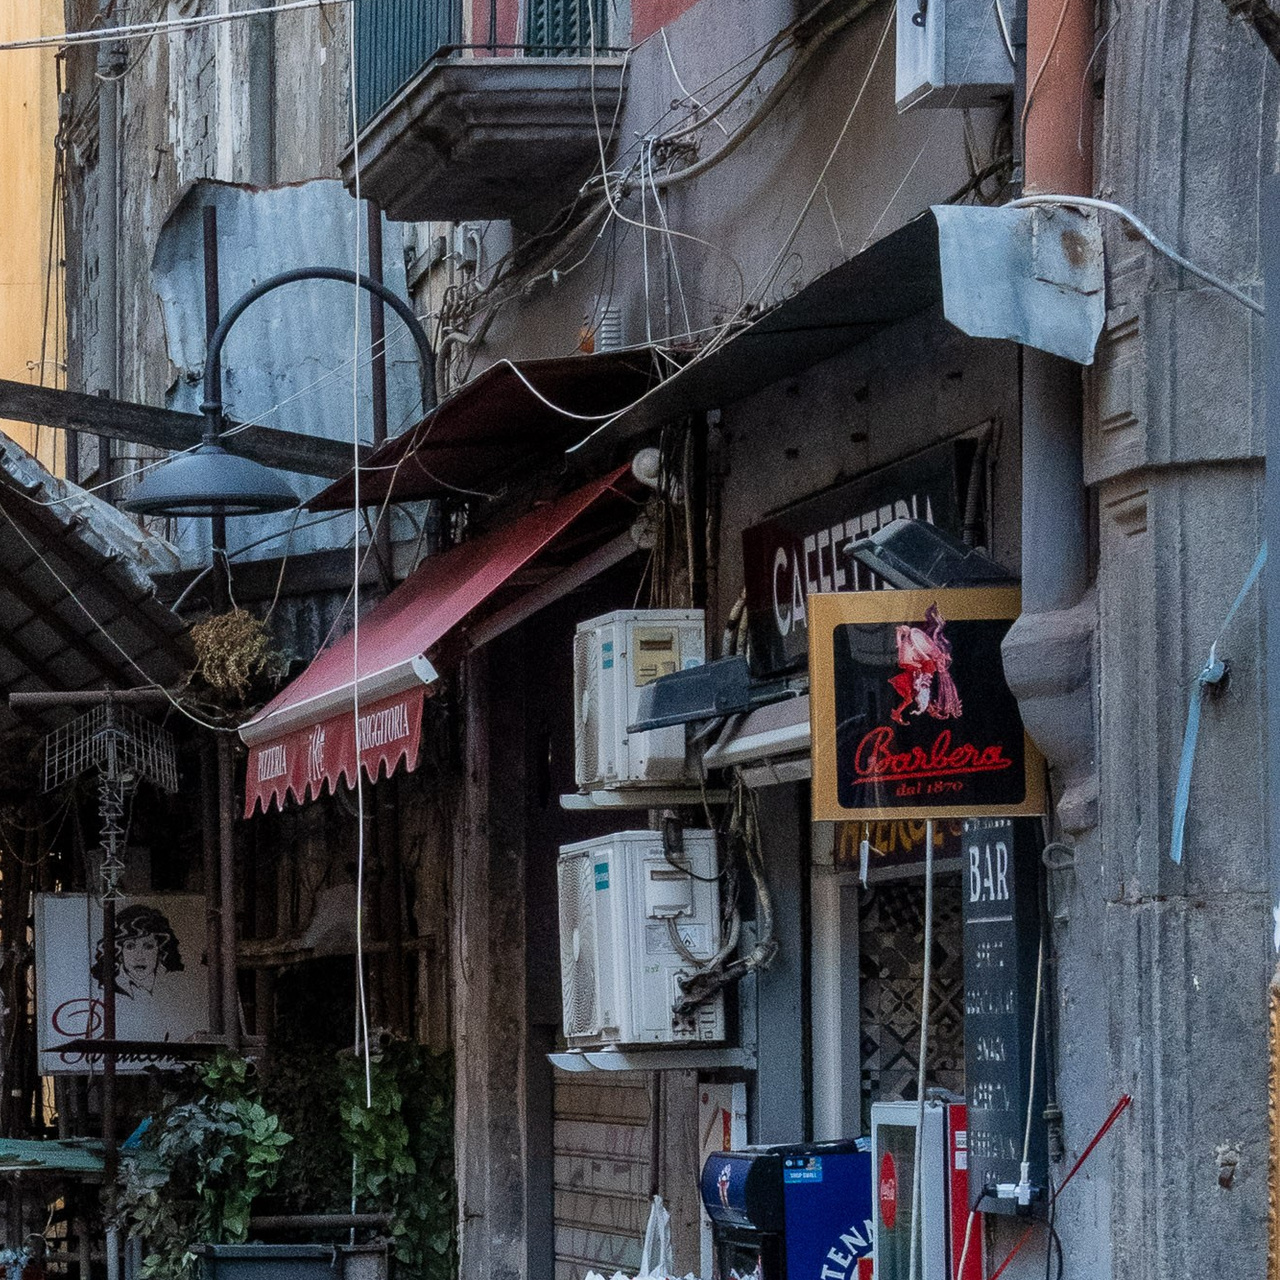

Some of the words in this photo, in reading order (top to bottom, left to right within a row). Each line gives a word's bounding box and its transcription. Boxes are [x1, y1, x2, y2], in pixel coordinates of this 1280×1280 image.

[853, 725, 1013, 776] Barbera
[926, 780, 963, 795] 1870
[969, 841, 1010, 903] BAR
